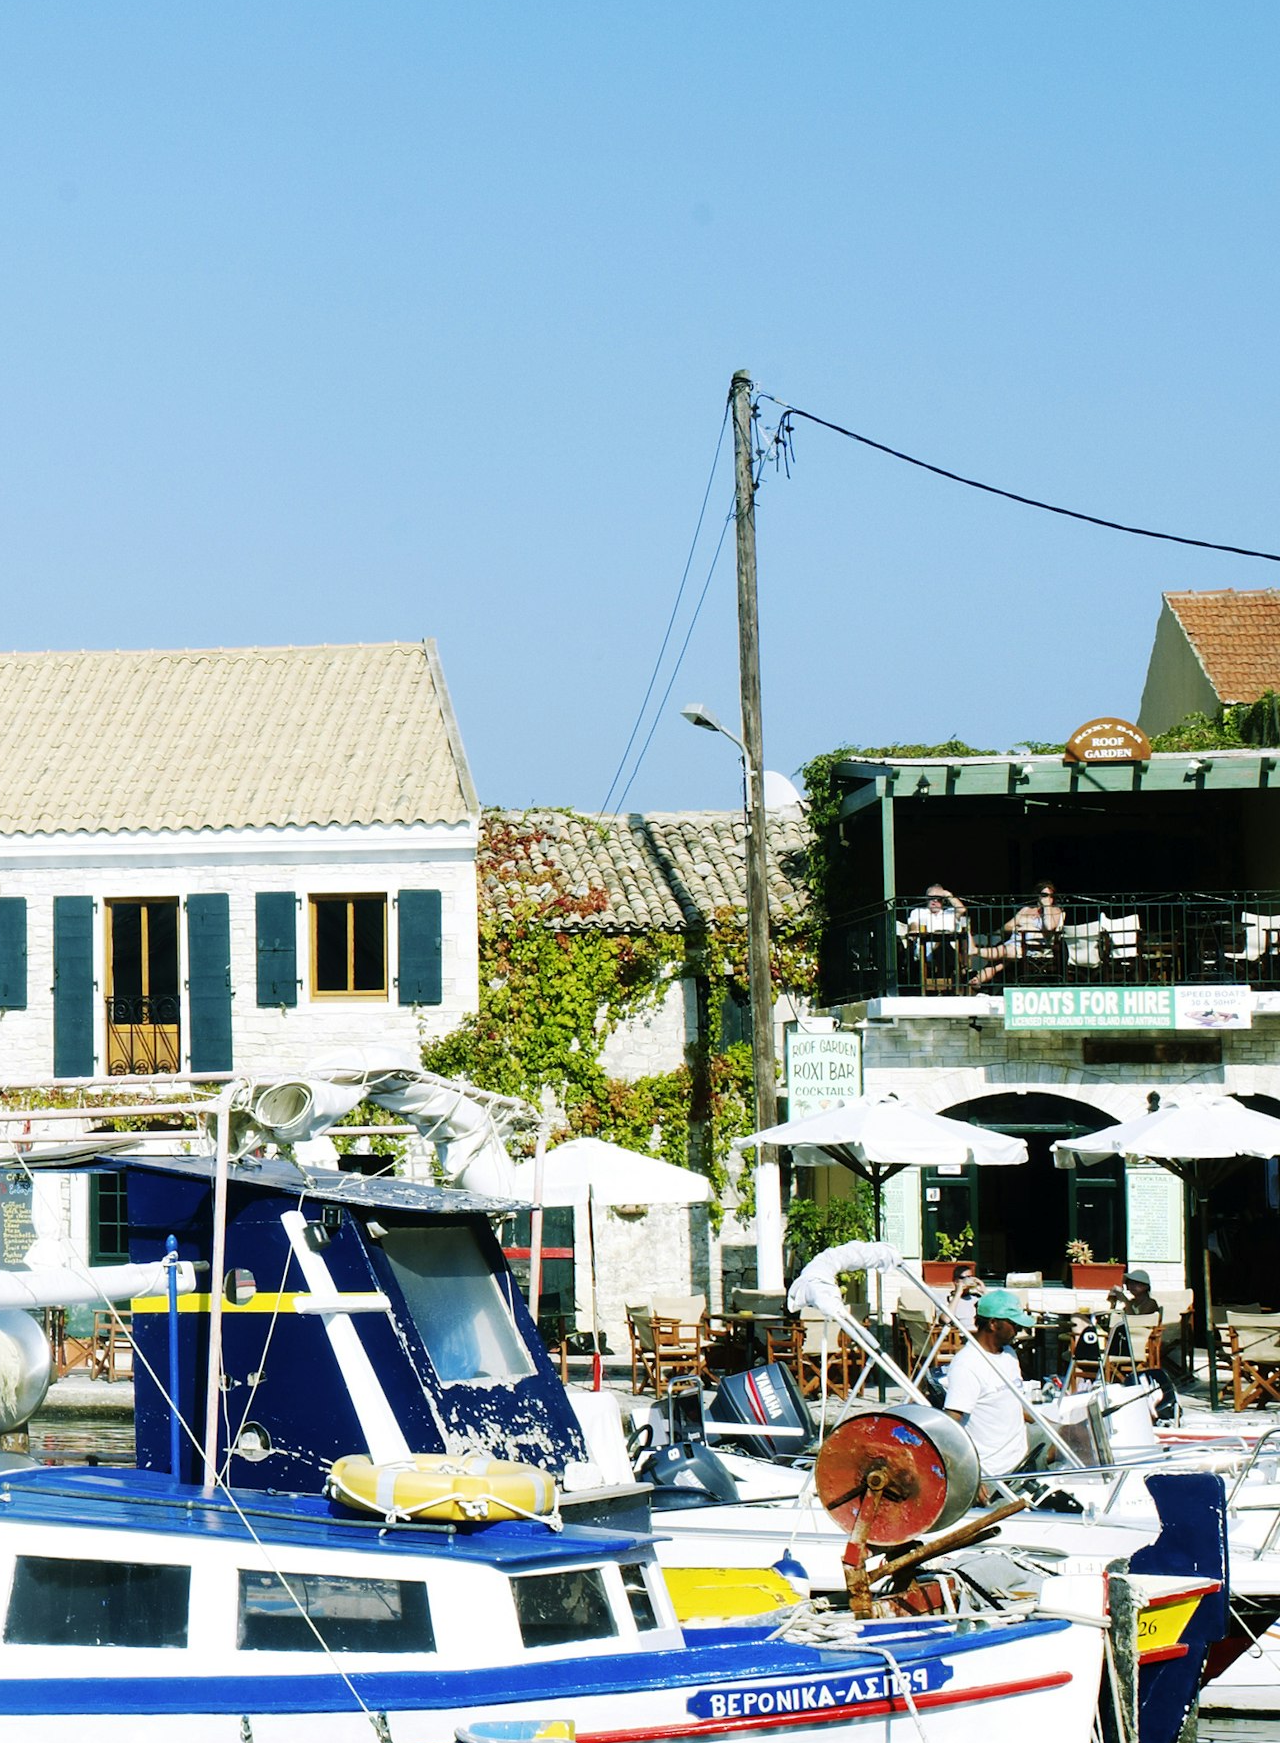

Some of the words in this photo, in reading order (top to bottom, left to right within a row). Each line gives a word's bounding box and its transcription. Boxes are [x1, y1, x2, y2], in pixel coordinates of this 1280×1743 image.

[1074, 724, 1112, 744] ROXY
[1116, 725, 1143, 744] BAR
[1091, 737, 1125, 747] ROOF
[1084, 748, 1132, 759] GARDEN
[1180, 990, 1212, 998] SPEED
[1214, 990, 1247, 998] BOATS
[1011, 991, 1074, 1015] BOATS
[1080, 991, 1119, 1015] FOR
[1124, 991, 1170, 1014] HIRE
[1042, 1016, 1056, 1026] FOR
[1056, 1016, 1083, 1026] AROUND
[1084, 1016, 1097, 1026] THE
[1097, 1016, 1120, 1026] ISLAND
[1120, 1016, 1135, 1026] AND
[792, 1040, 816, 1058] ROOF
[819, 1039, 856, 1058] GARDEN
[793, 1061, 824, 1081] ROXI
[829, 1061, 855, 1081] BAR
[795, 1086, 854, 1097] COCKTAILS
[755, 1371, 783, 1420] YAMAHA
